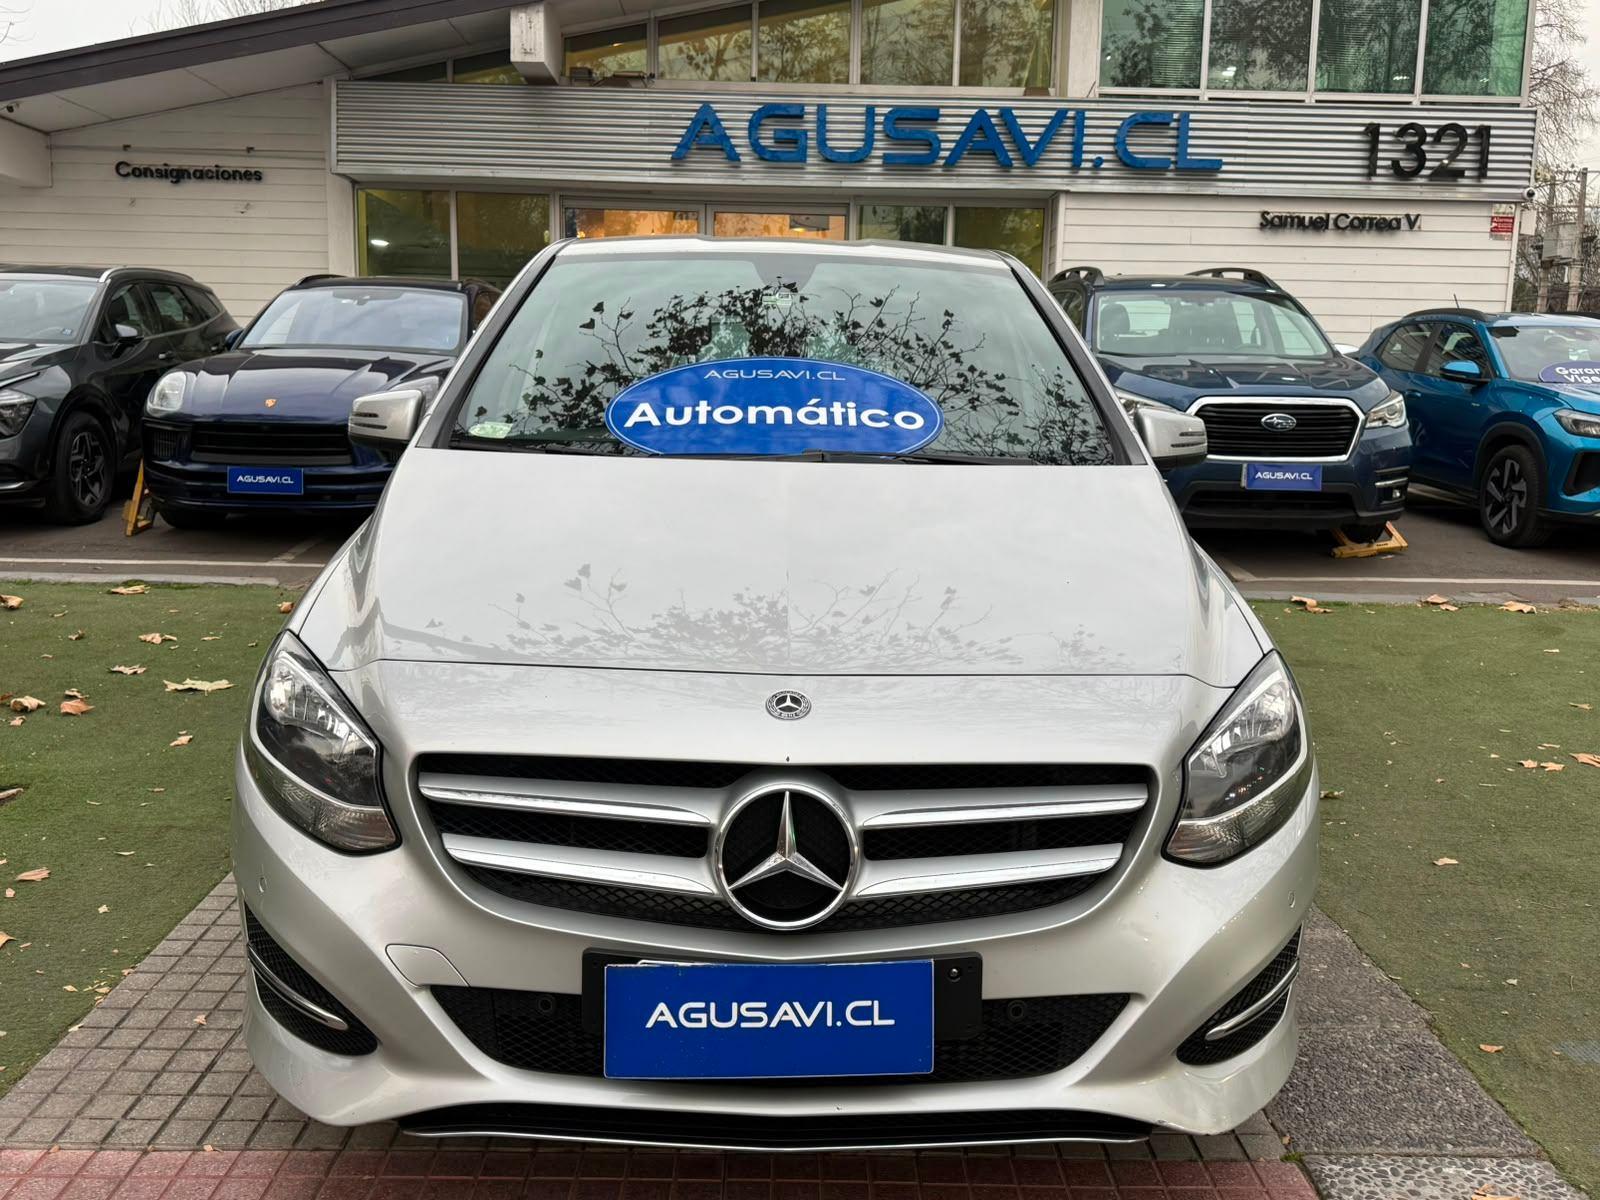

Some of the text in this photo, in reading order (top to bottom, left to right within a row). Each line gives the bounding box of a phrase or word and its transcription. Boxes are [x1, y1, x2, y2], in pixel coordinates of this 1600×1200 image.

[671, 103, 1223, 171] AGUSAVI.CL
[1363, 122, 1491, 181] 1321
[115, 161, 263, 184] Consignaciones
[1259, 211, 1330, 231] Samuel
[1333, 213, 1401, 231] Correa
[703, 369, 846, 381] AGUSAVI.CL
[623, 398, 925, 431] Automático
[236, 474, 295, 484] AGUSAVI.CL
[1254, 471, 1314, 481] AGUSAVI.CL
[645, 1000, 896, 1029] AGUSAVI.CL
